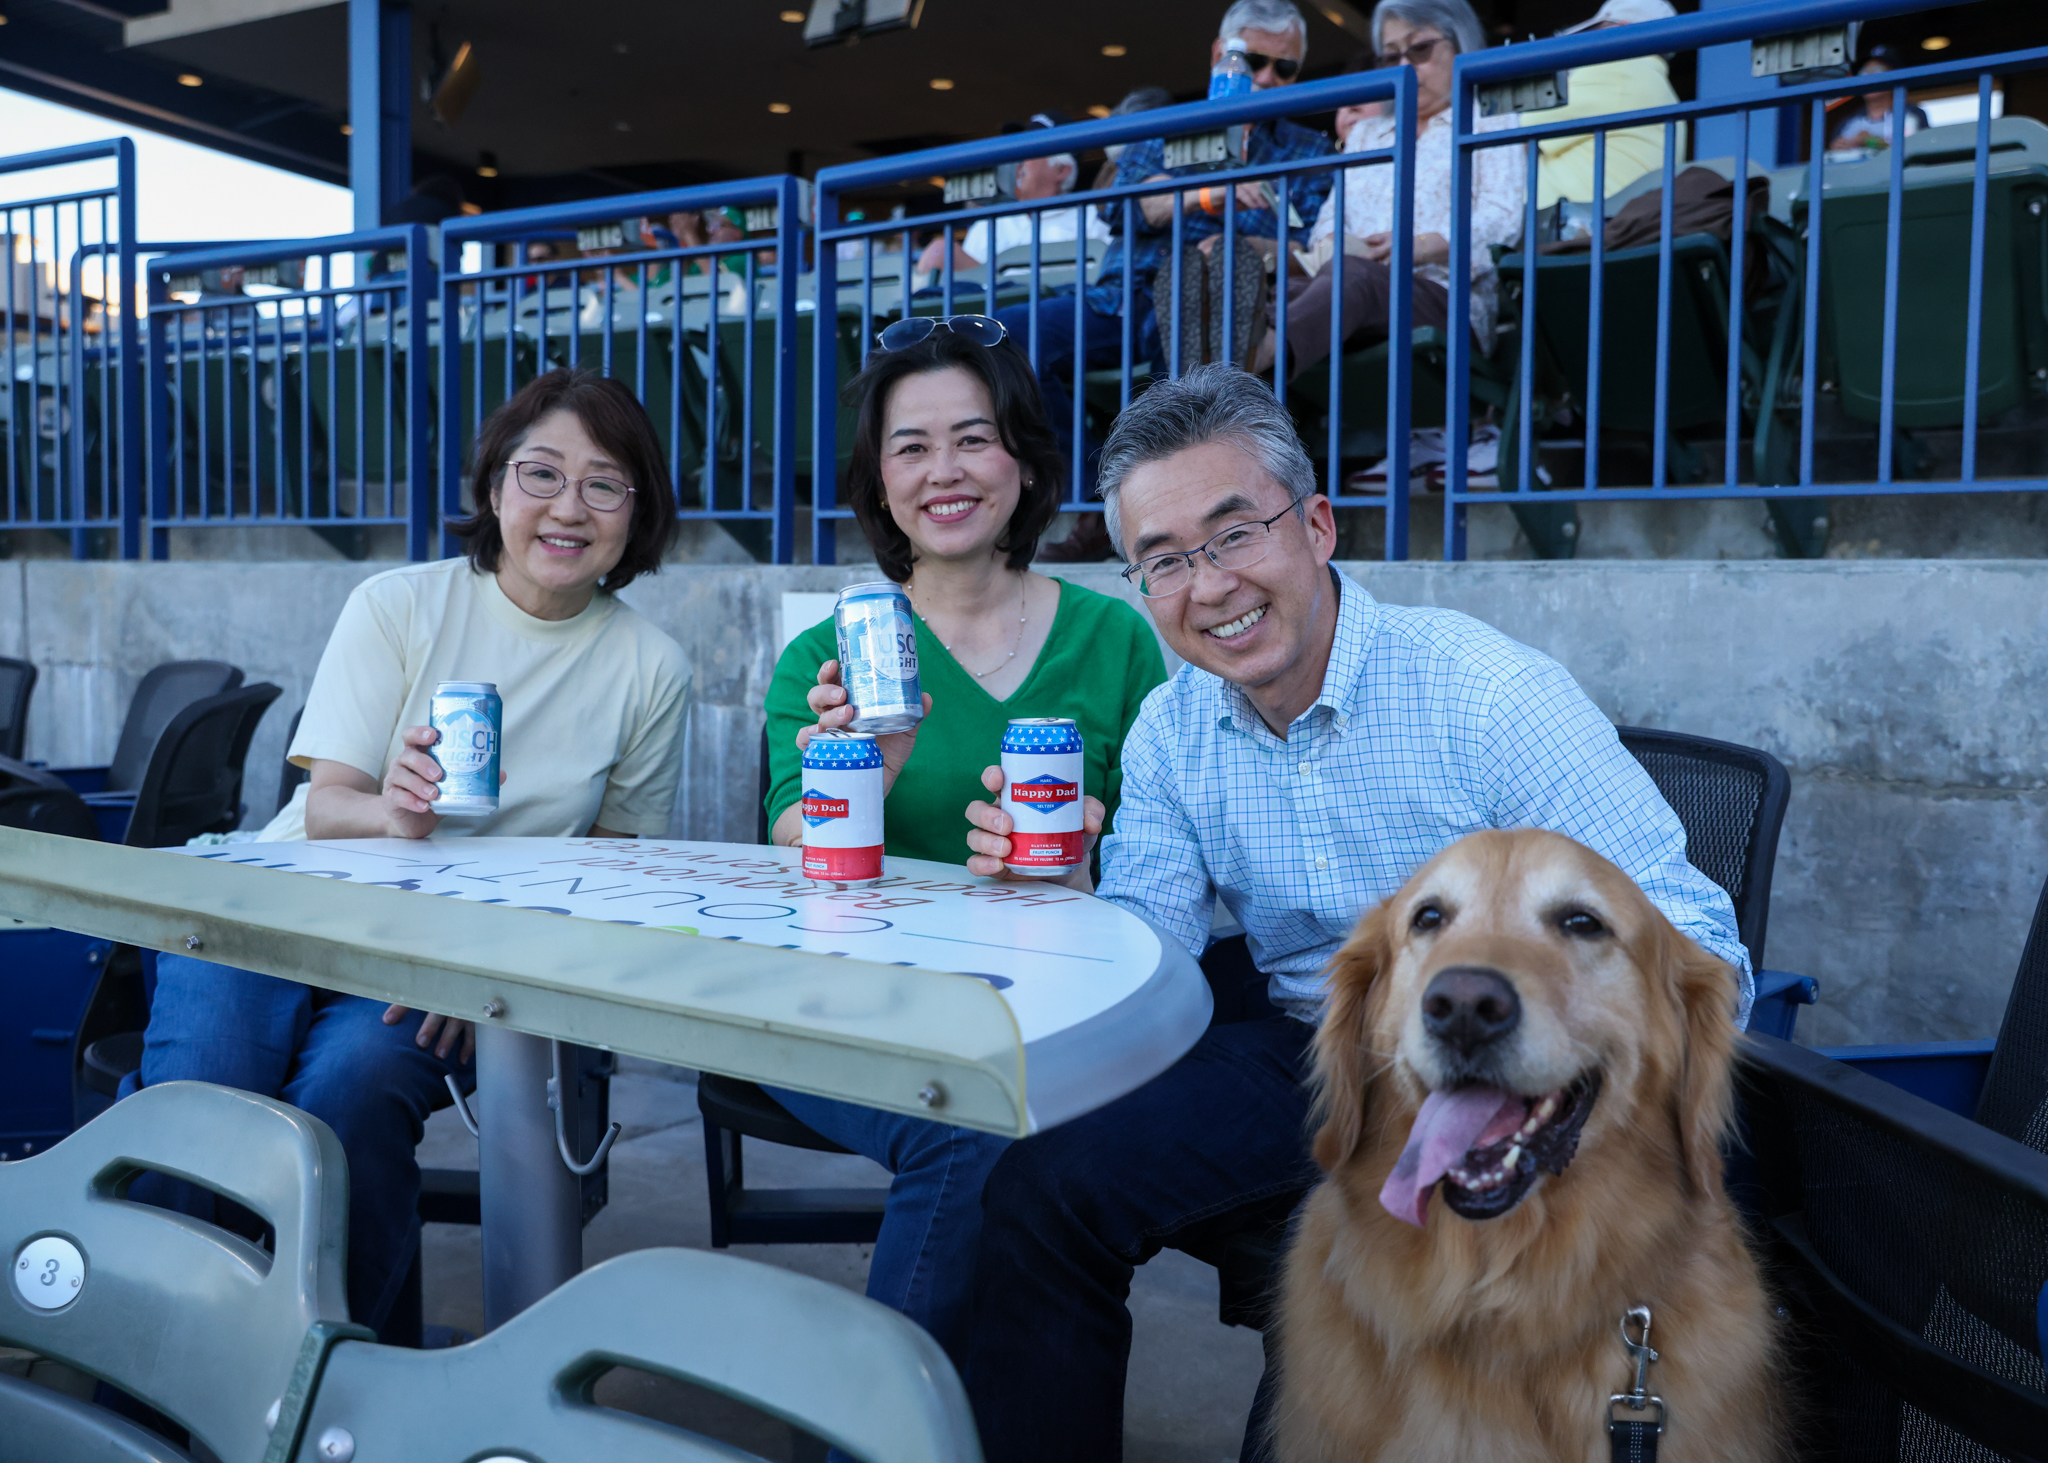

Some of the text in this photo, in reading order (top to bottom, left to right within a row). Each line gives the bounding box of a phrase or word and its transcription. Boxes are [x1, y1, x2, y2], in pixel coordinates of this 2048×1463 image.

[861, 633, 917, 659] BUSC
[880, 657, 917, 669] LIGHT
[442, 752, 486, 763] LIGHT
[1013, 787, 1076, 799] Happy Dad
[821, 804, 845, 812] Dad
[539, 857, 935, 910] Behavioral
[876, 876, 1083, 907] Healt
[397, 861, 893, 934] COUNTY
[40, 1258, 60, 1287] 3
